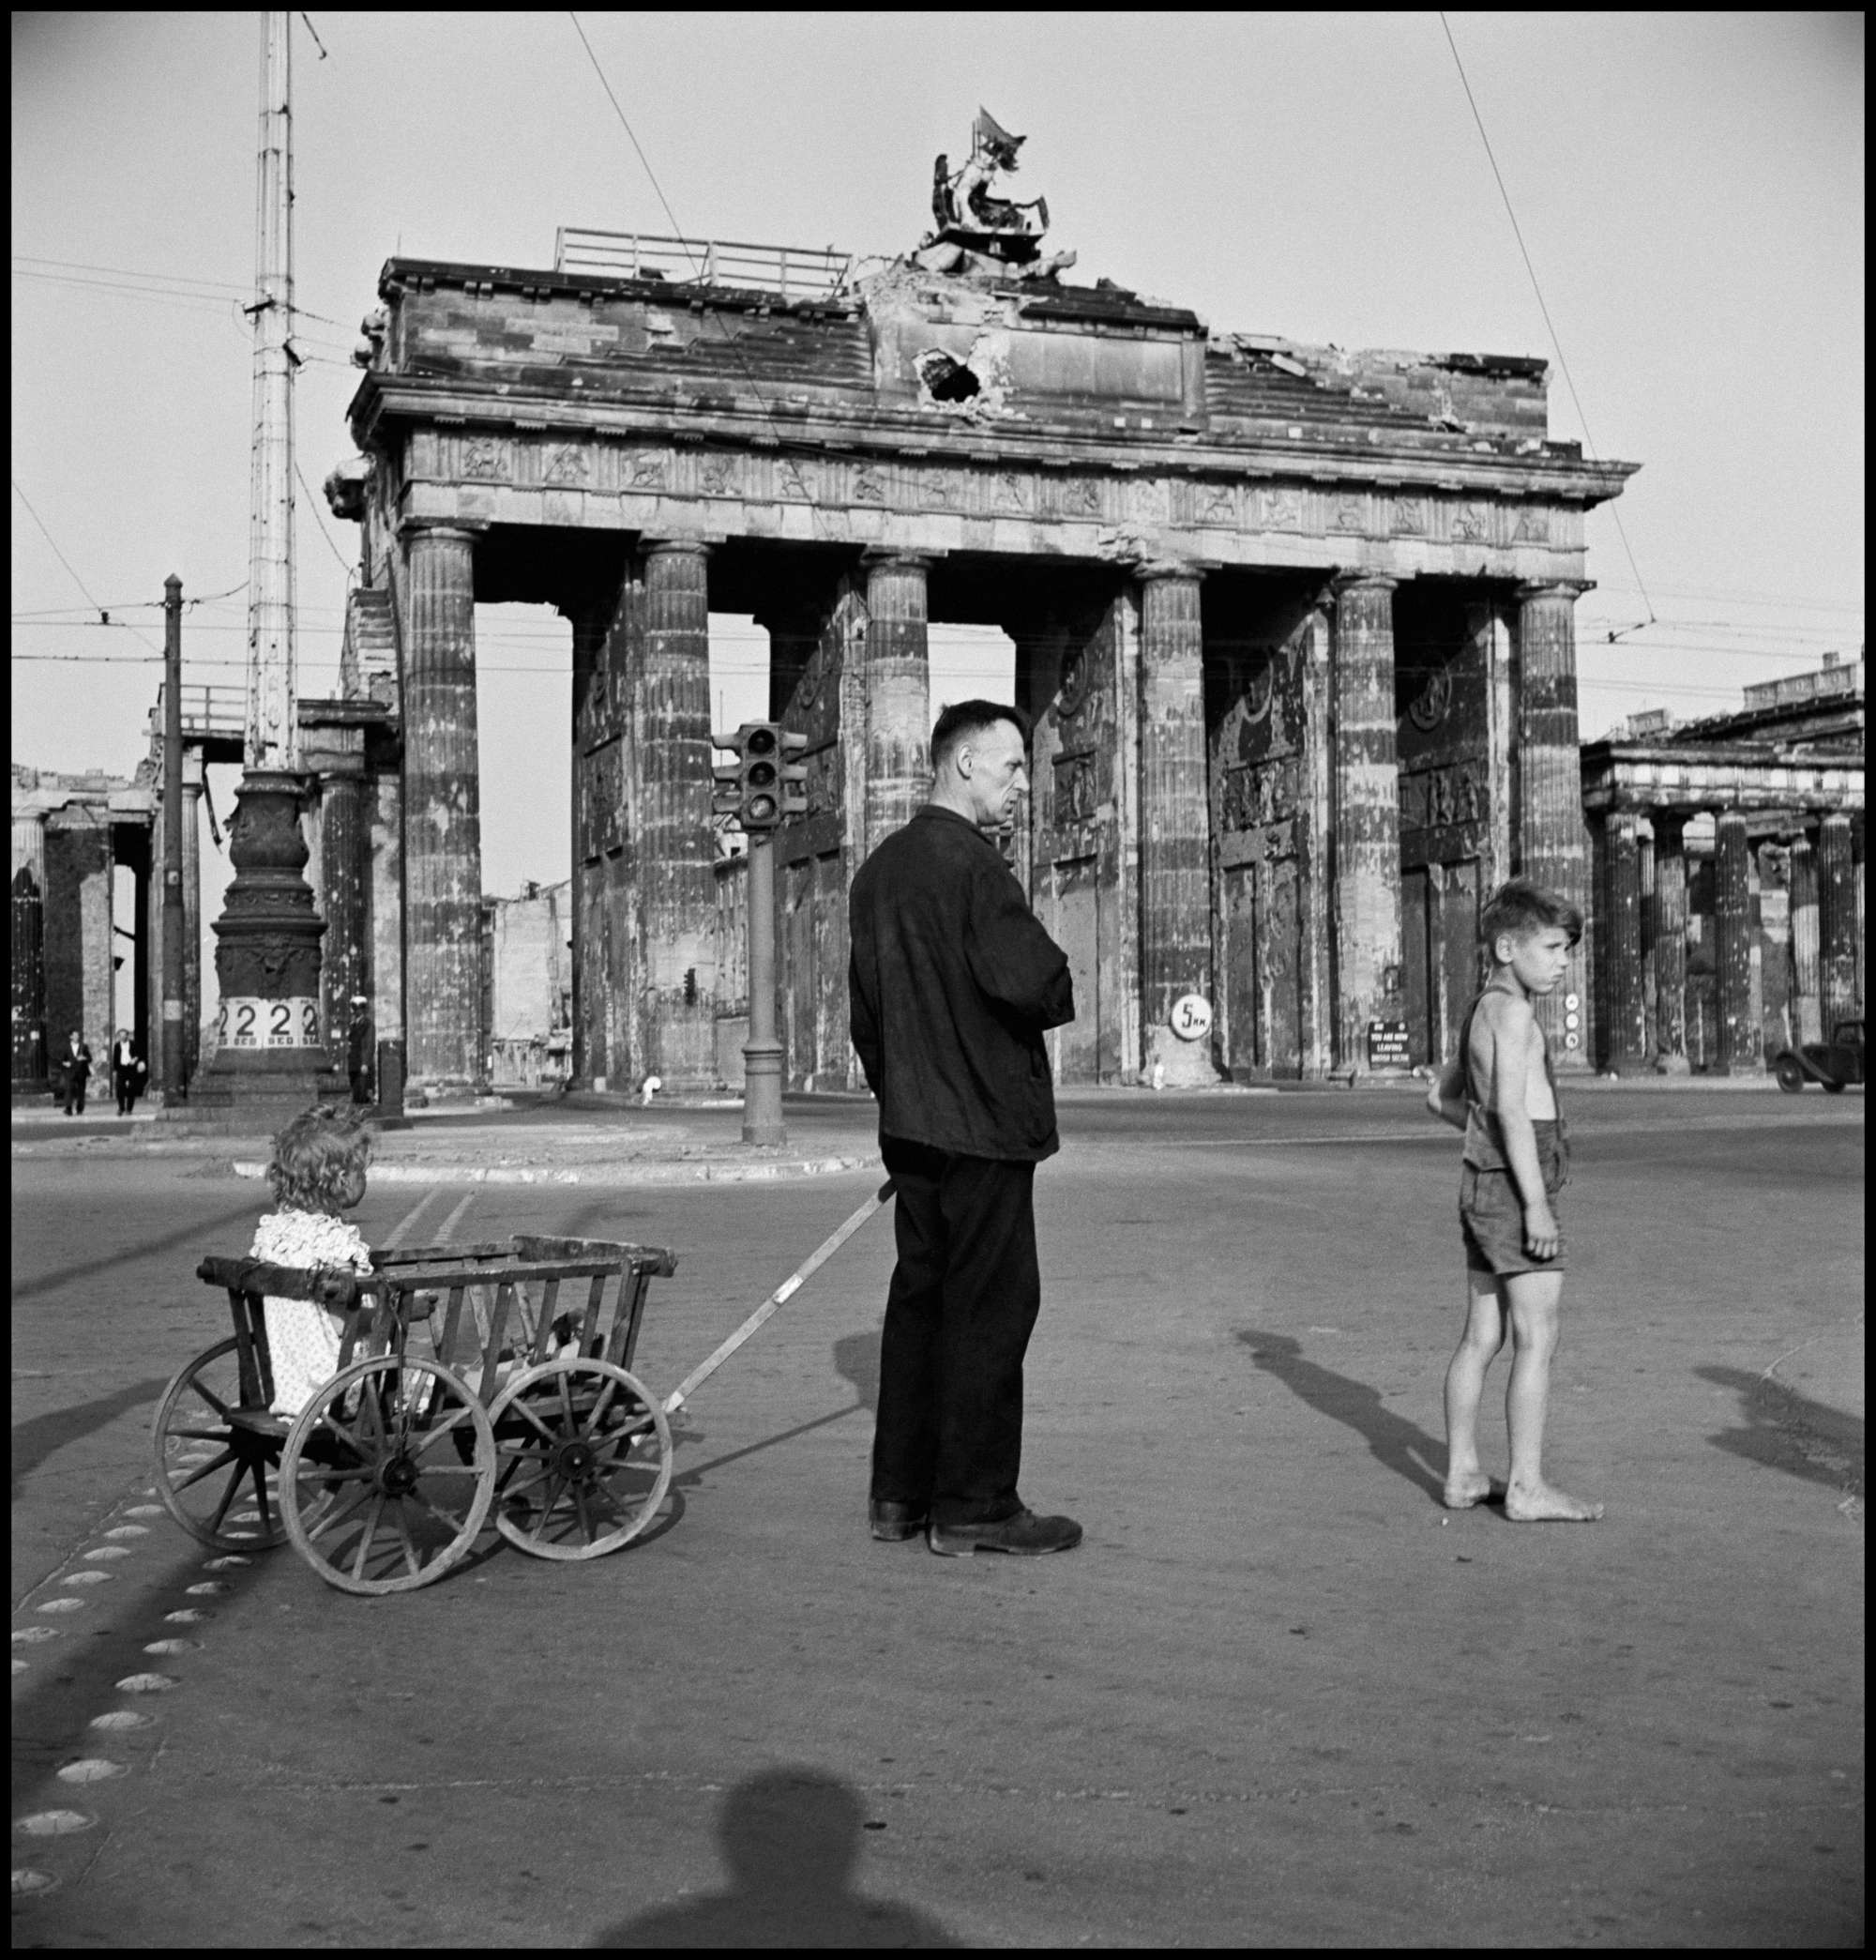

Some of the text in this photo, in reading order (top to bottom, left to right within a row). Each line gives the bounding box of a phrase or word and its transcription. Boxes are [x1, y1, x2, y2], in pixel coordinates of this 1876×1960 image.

[237, 1005, 256, 1036] 2
[270, 1005, 291, 1036] 2
[1182, 1004, 1193, 1027] 5
[1377, 1043, 1402, 1052] LEAVING
